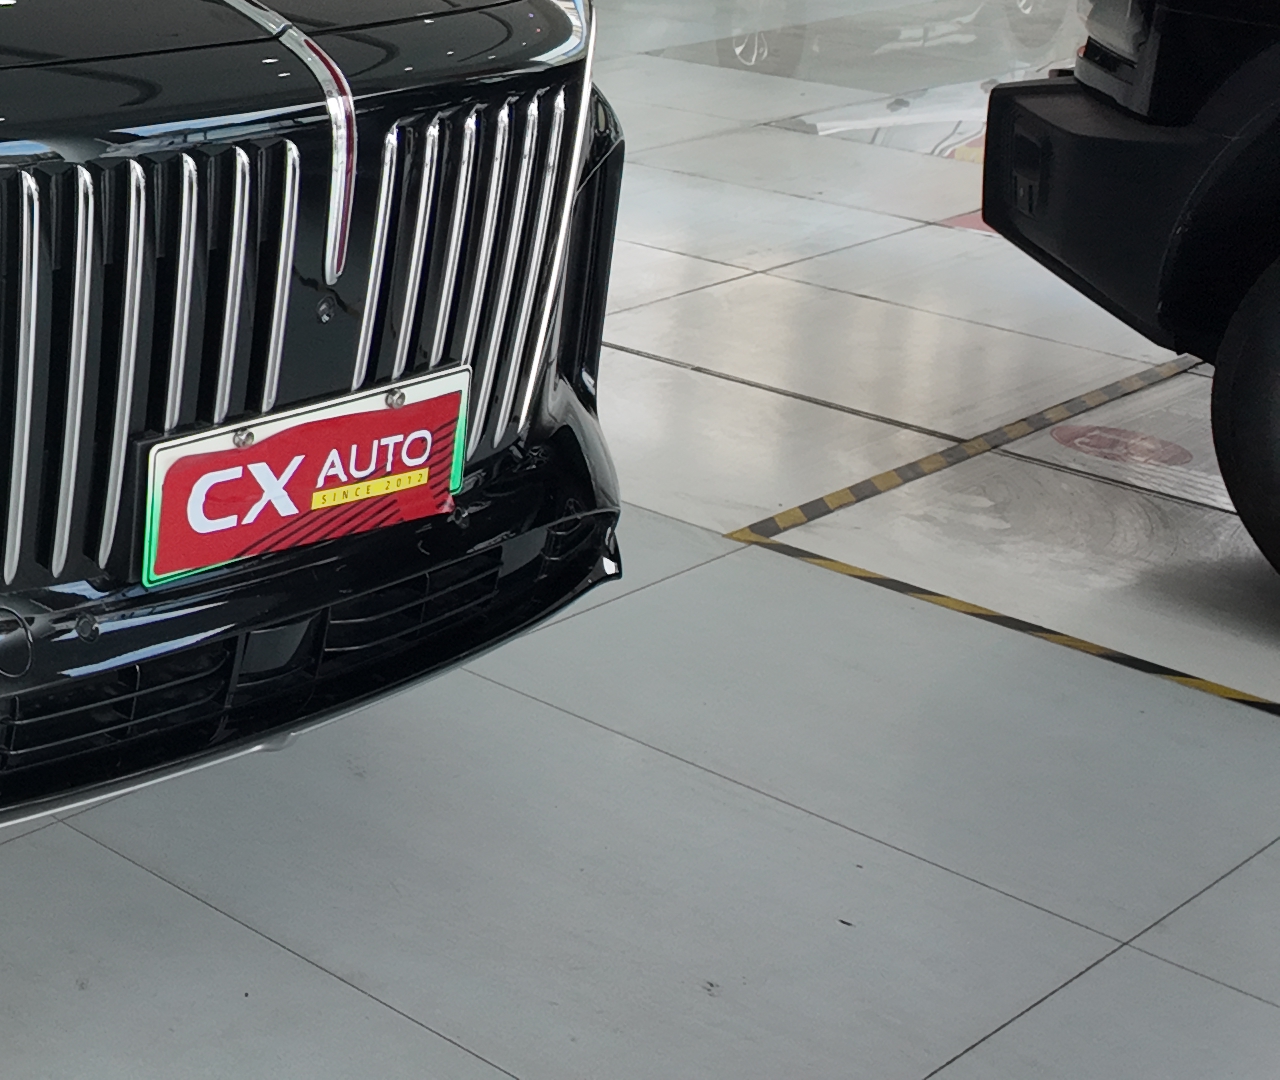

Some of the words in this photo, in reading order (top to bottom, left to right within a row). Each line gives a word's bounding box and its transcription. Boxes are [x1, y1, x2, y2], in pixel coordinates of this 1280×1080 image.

[187, 454, 306, 534] CX
[316, 429, 432, 488] AUTO
[321, 485, 372, 505] SINCE
[385, 473, 424, 491] 2012
